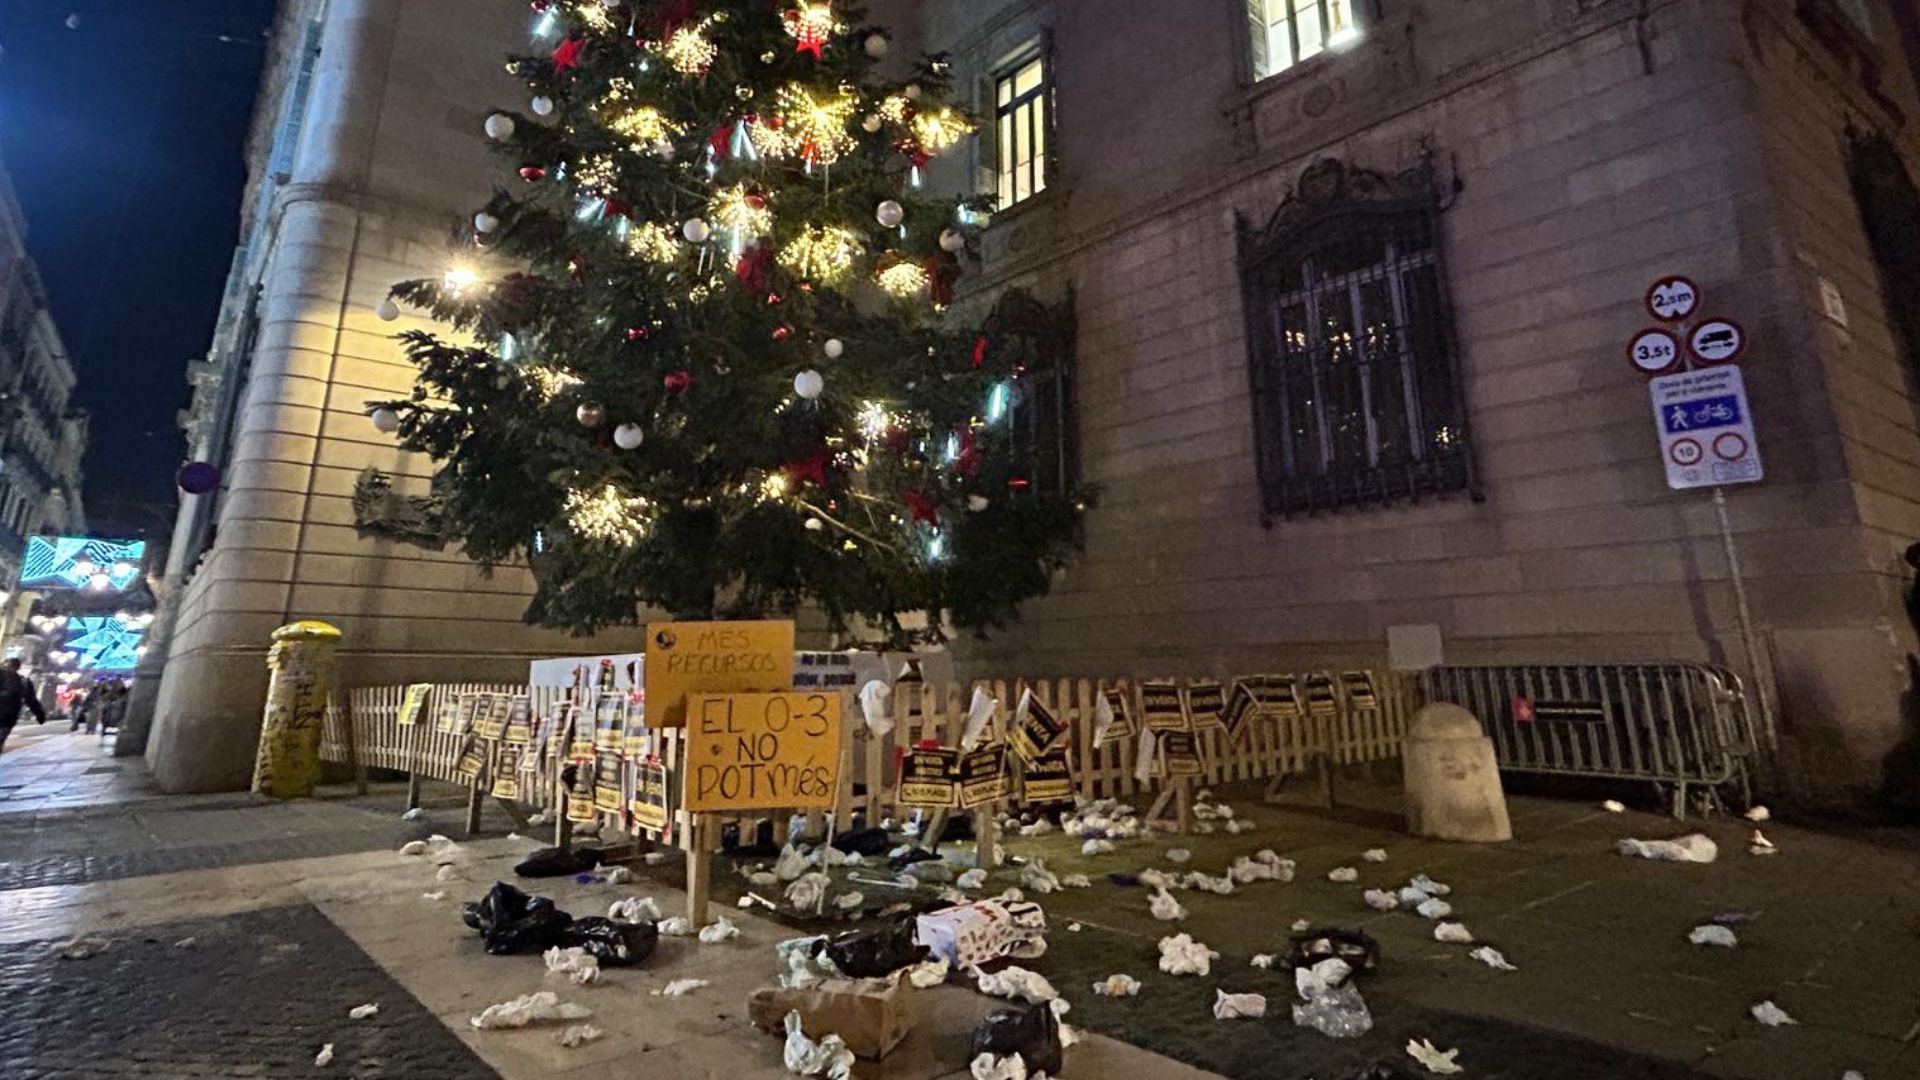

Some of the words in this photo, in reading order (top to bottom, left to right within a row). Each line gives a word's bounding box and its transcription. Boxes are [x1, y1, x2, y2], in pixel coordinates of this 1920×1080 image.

[1637, 345, 1671, 360] 3.5t
[1679, 446, 1694, 458] 10
[667, 652, 777, 675] RECURSOS
[702, 698, 744, 734] EL
[737, 732, 778, 762] NO
[697, 763, 765, 801] POT
